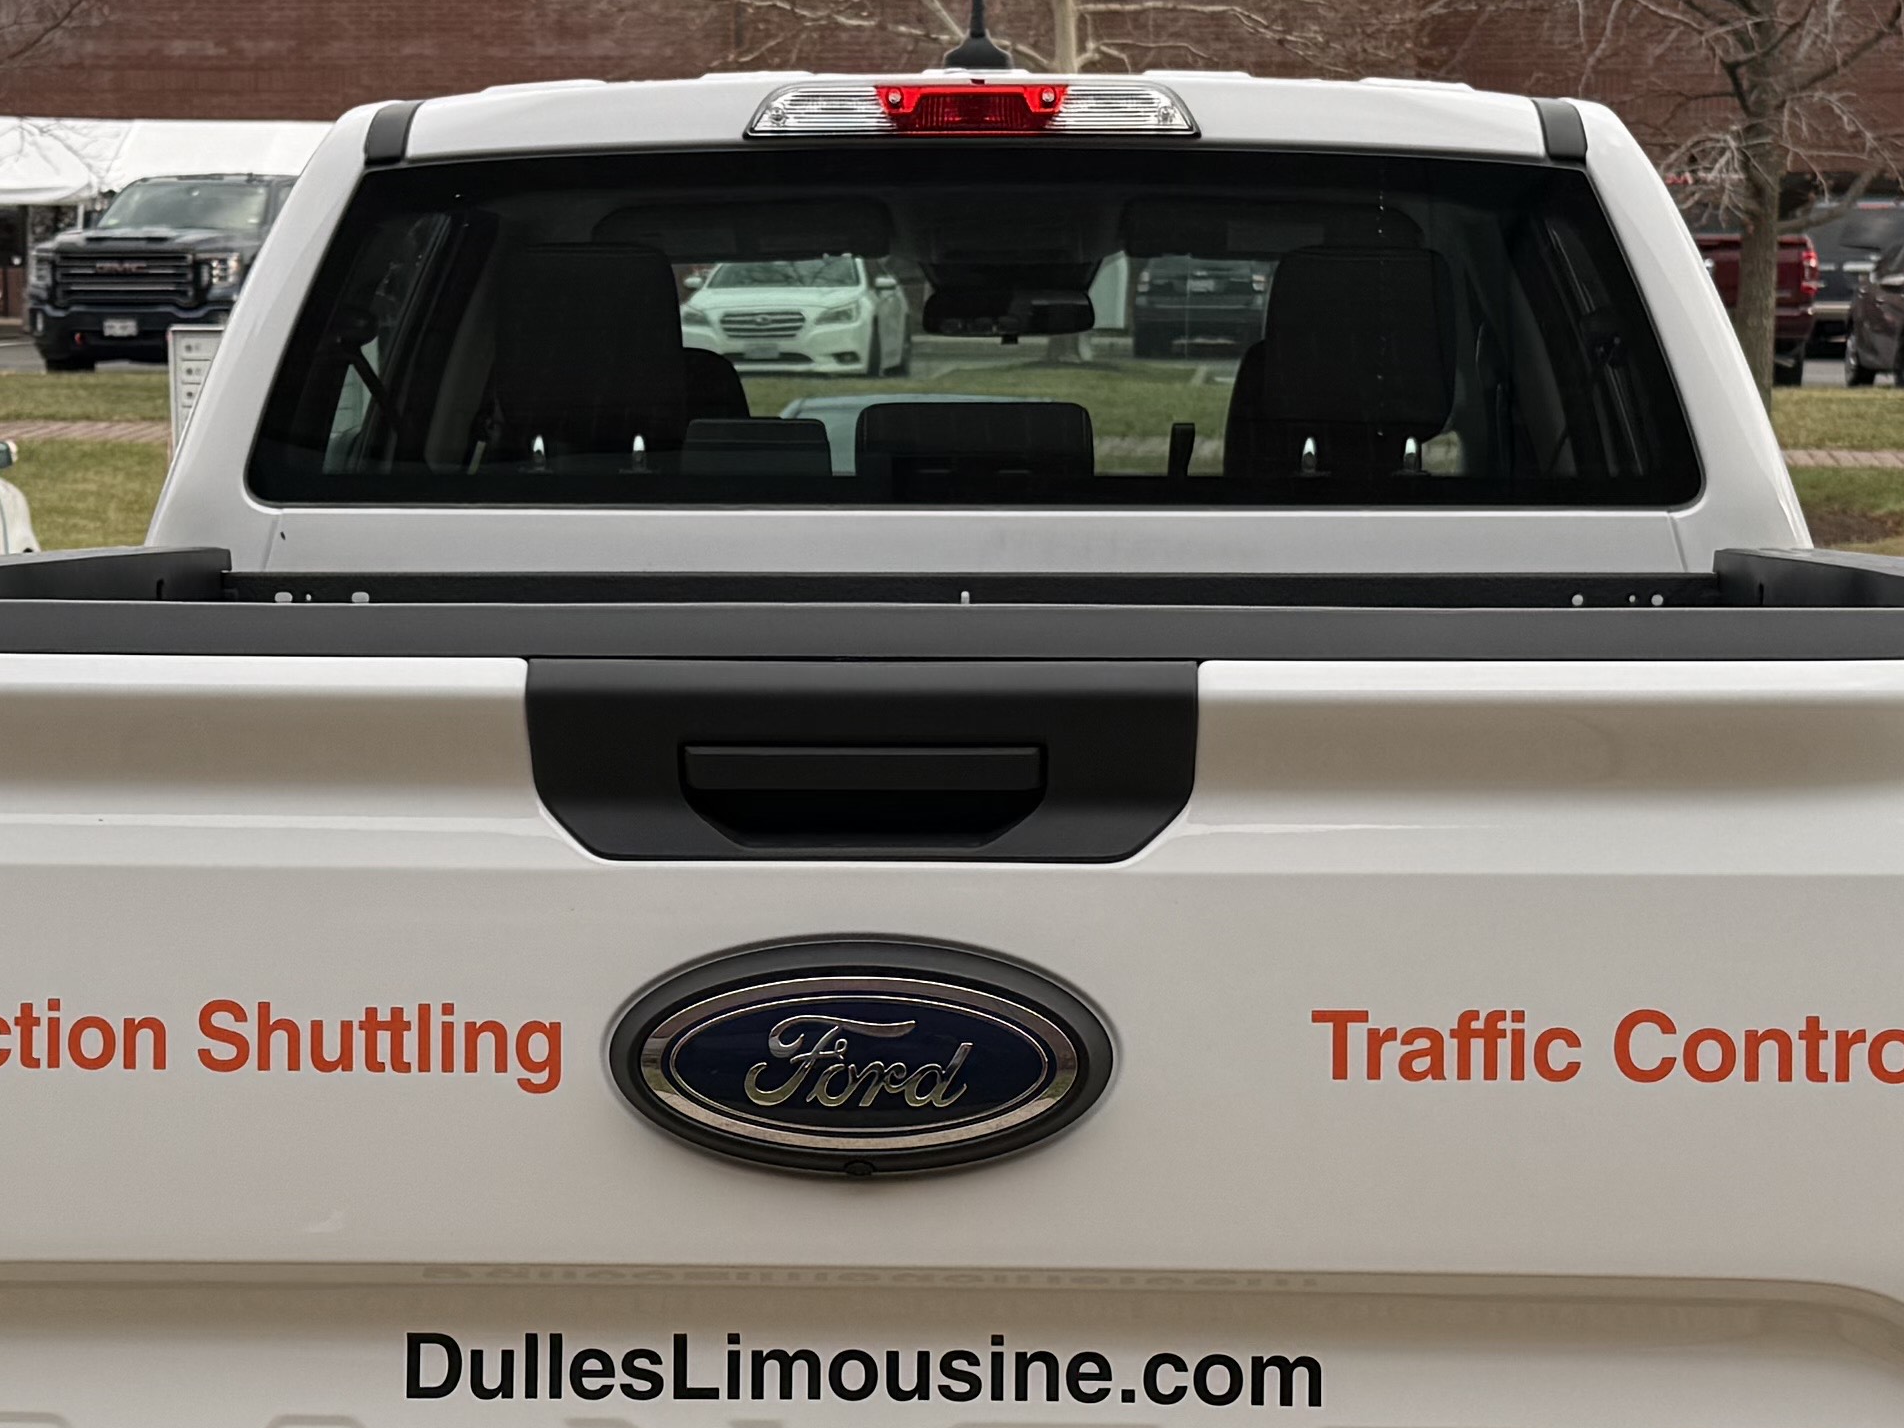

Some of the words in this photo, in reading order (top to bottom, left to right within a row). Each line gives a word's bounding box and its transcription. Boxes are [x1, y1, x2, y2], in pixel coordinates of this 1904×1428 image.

[197, 999, 563, 1094] Shuttling
[744, 1014, 974, 1108] Ford
[1311, 1009, 1582, 1083] Traffic
[406, 1332, 1323, 1408] DullesLimousine.com
